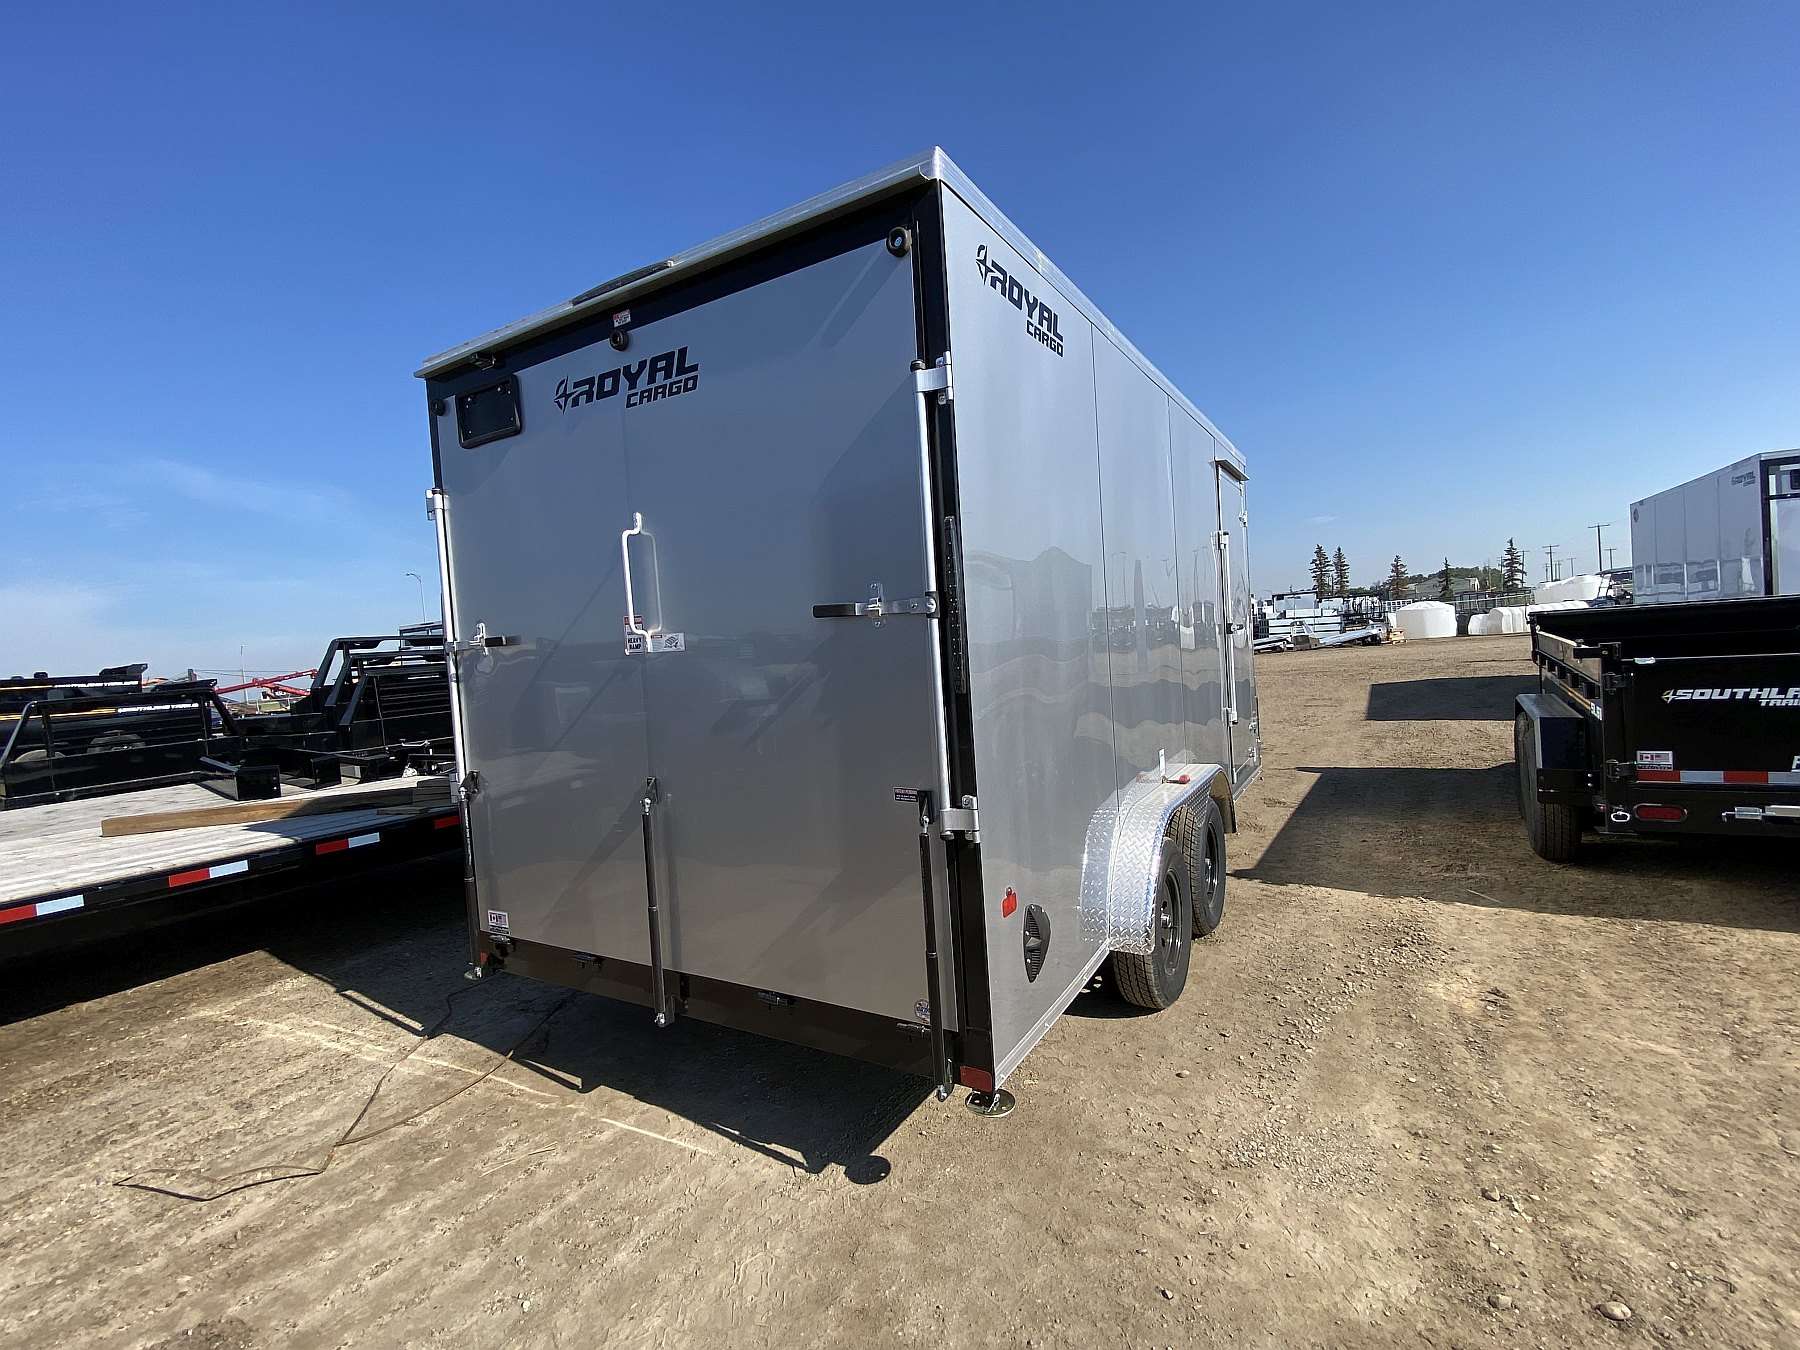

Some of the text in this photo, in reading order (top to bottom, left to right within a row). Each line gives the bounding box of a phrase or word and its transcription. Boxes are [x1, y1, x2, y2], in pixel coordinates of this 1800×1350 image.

[990, 259, 1064, 343] ROYAL
[1026, 319, 1064, 358] CARGO
[571, 346, 699, 407] ROYAL
[625, 374, 699, 409] CARGO
